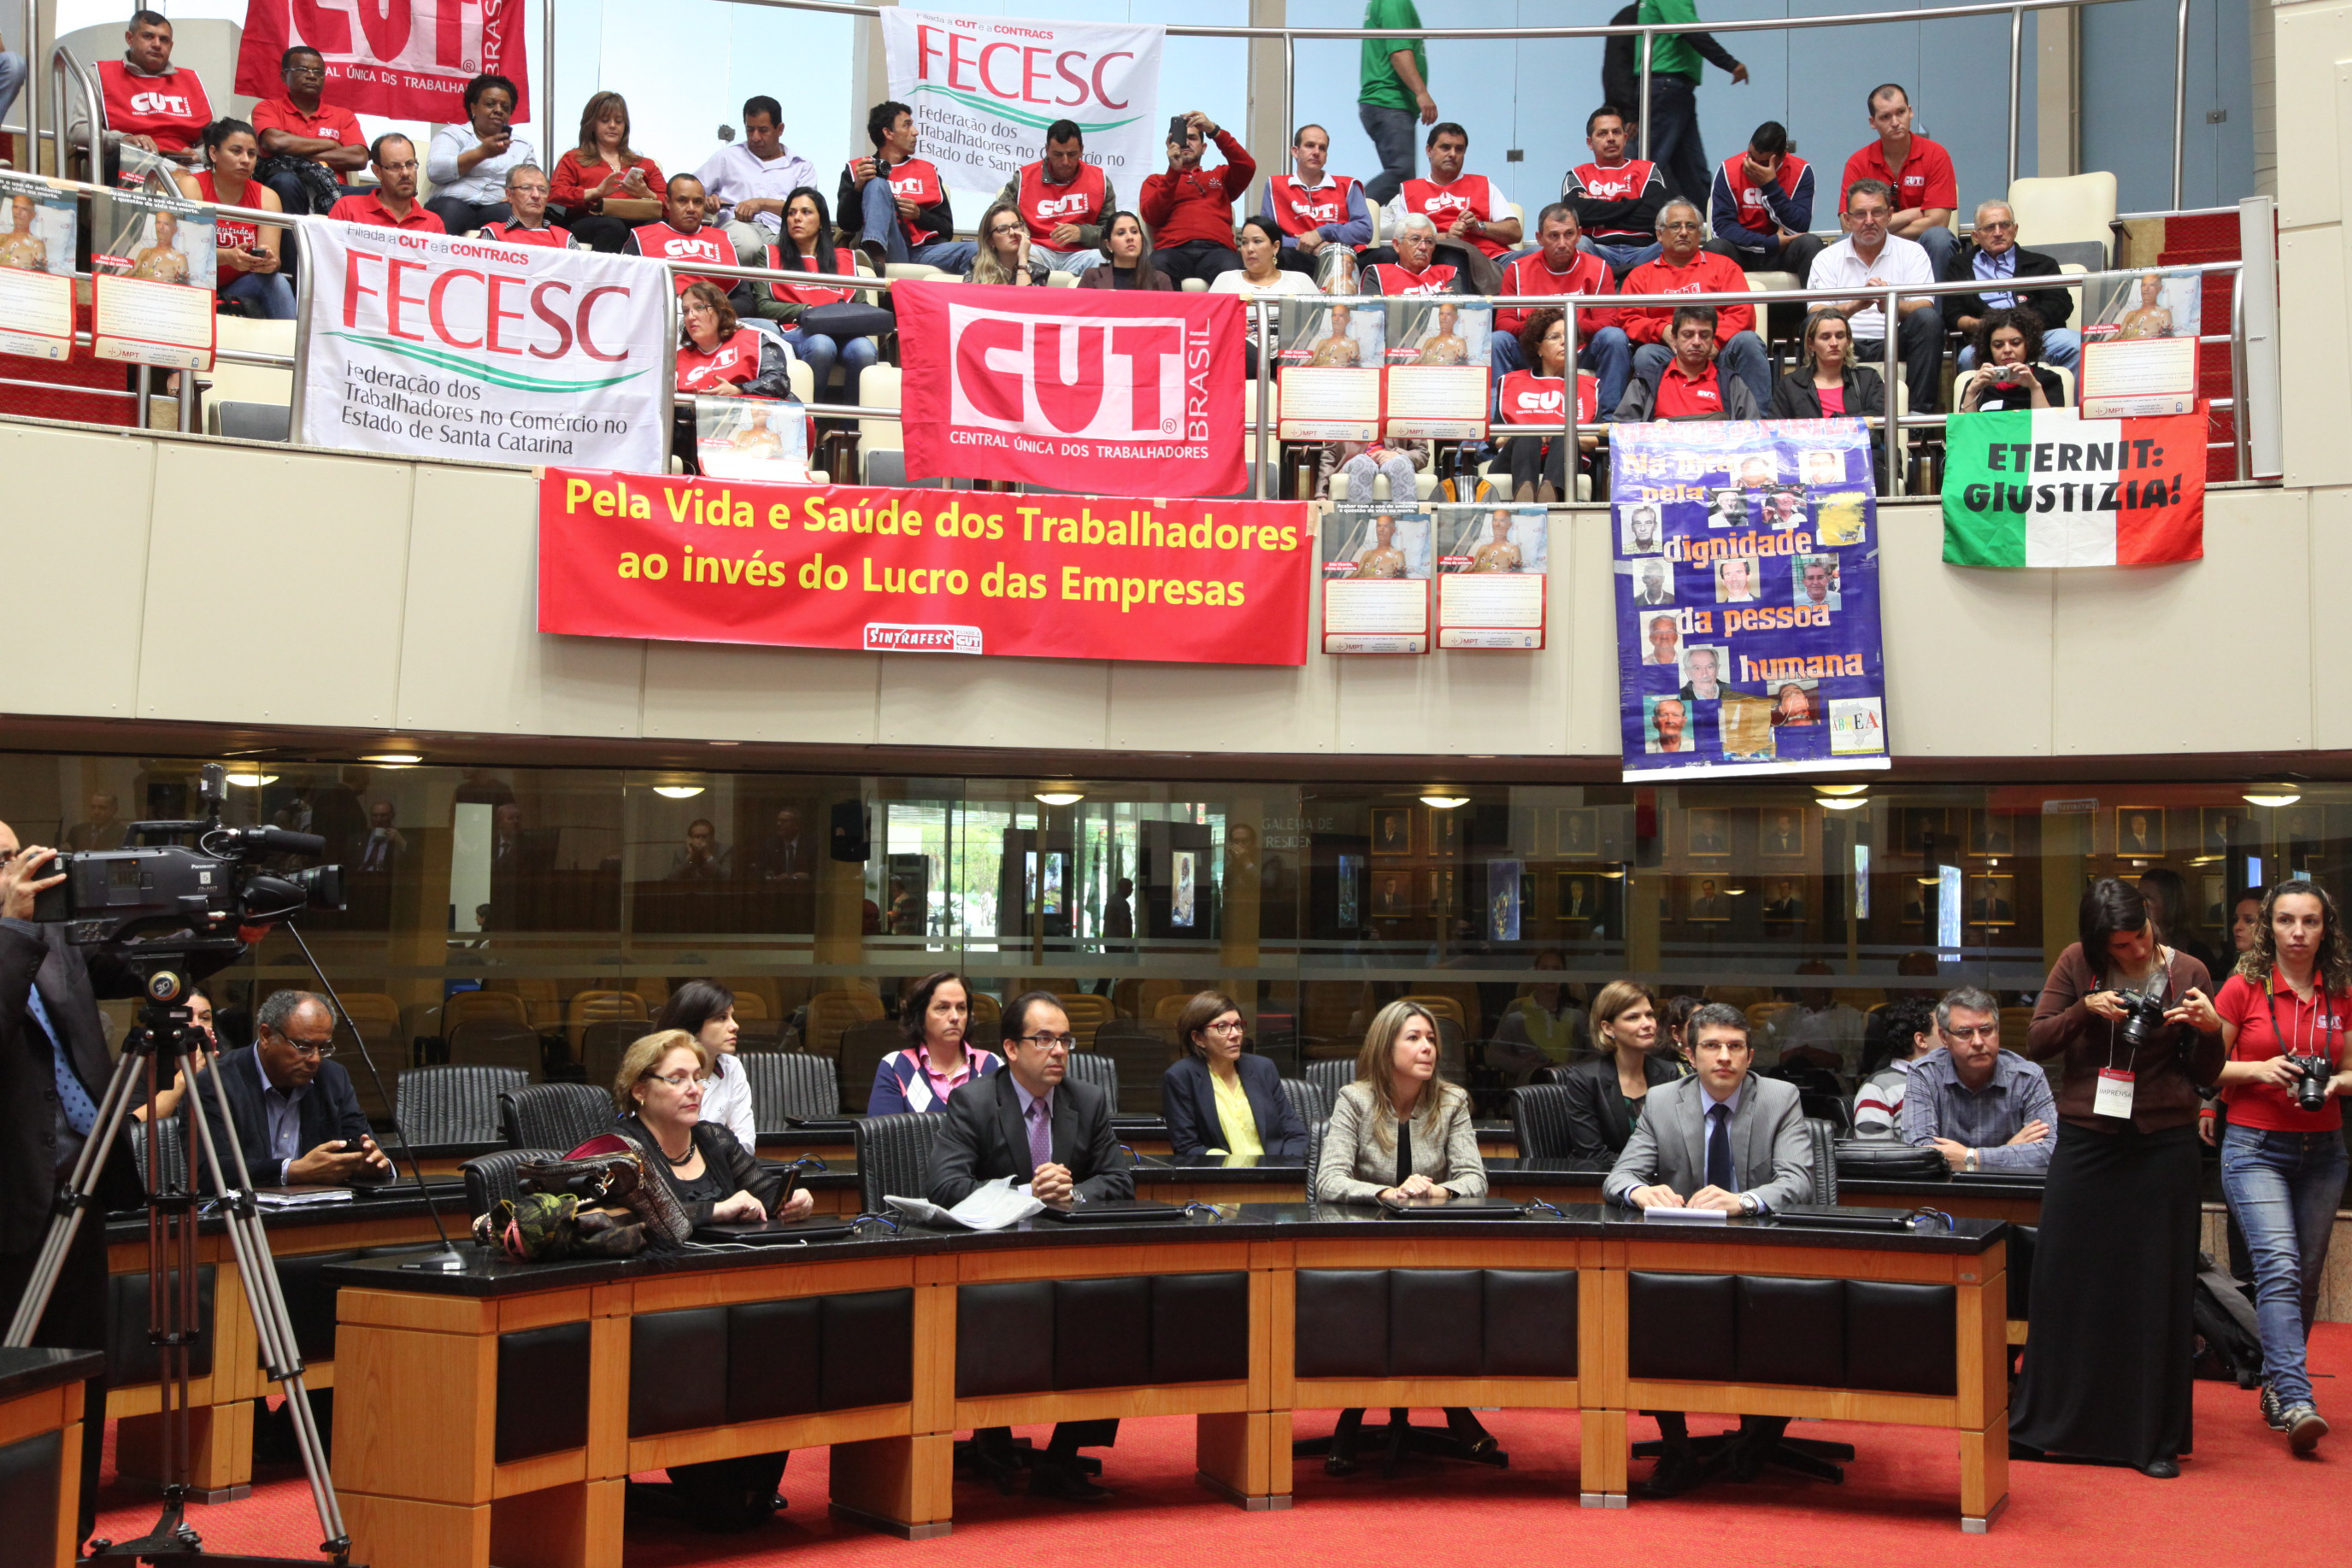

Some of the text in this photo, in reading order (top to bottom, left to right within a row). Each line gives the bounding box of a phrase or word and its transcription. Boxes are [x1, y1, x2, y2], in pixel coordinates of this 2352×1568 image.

[485, 0, 503, 76] BRAS
[955, 19, 978, 30] CUT
[993, 25, 1054, 40] CONTRACS
[347, 65, 376, 81] ÚNICA
[403, 76, 465, 94] TRABALHA
[917, 24, 1134, 109] FECESC
[131, 92, 184, 113] CUT
[919, 104, 1018, 138] Federação dos
[919, 122, 1011, 156] Trabalhadores
[1016, 144, 1035, 159] no
[1107, 155, 1125, 167] no
[919, 139, 961, 162] Estado
[966, 150, 984, 167] de
[35, 185, 62, 195] amianto
[887, 178, 918, 194] UT
[1425, 191, 1466, 210] CUT
[118, 197, 144, 206] questão
[179, 206, 200, 214] morte.
[176, 201, 202, 210] amianto
[1038, 193, 1083, 215] CUT
[347, 224, 529, 265] Filiada a CUT e a CONTRACS
[664, 239, 714, 257] CUT
[342, 248, 631, 362] FECESC
[347, 359, 481, 401] Federação dos
[956, 318, 1181, 434] CUT
[1188, 318, 1210, 441] BRASIL
[344, 382, 627, 434] Trabalhadores no Comércio no
[342, 406, 573, 455] Estado de Santa Catarina
[950, 431, 1208, 460] CENTRAL ÚNICA DOS TRABALHADORES
[1988, 439, 2164, 473] ETERNIT:
[1641, 484, 1704, 504] pela
[1963, 473, 2183, 514] GIUSTIZIA!
[566, 478, 1298, 551] Pela Vida e Saúde dos Trabalhadores
[1663, 528, 1812, 569] dignidade
[618, 545, 1245, 614] ao invés do Lucro das Empresas
[1675, 603, 1831, 637] da pessoa
[870, 630, 950, 645] SINTRAFESC
[957, 636, 979, 647] CUT
[1739, 653, 1865, 682] humana
[2099, 1089, 2132, 1098] IMPRENSA
